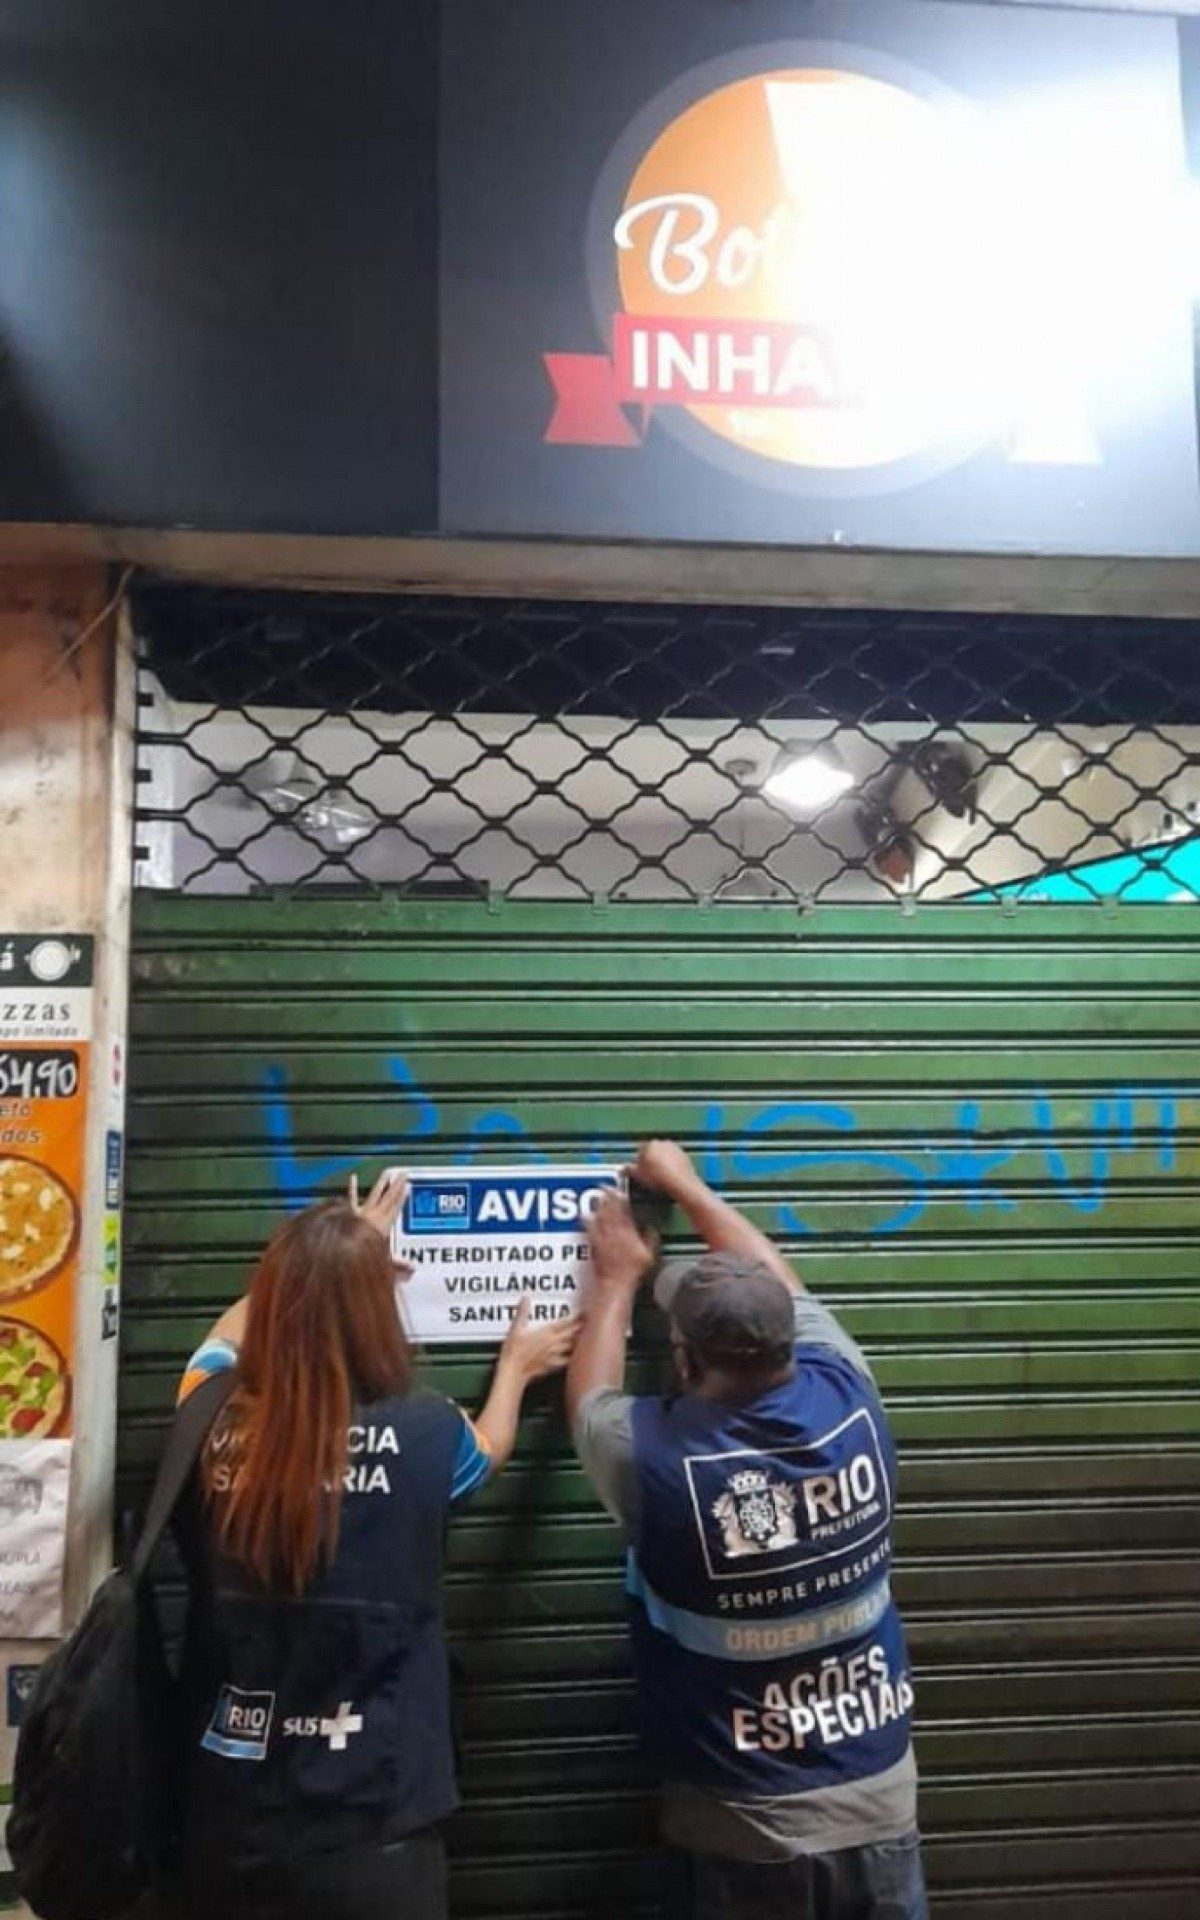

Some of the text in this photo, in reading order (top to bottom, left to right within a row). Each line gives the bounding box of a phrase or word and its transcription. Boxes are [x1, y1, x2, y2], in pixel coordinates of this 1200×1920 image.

[562, 1245, 588, 1261] PE
[444, 1272, 576, 1293] VIGILÂNCIA
[449, 1304, 570, 1323] SANITRIA
[803, 1454, 877, 1524] RIO
[717, 1582, 808, 1610] SEMPRE
[229, 1705, 266, 1728] RIO
